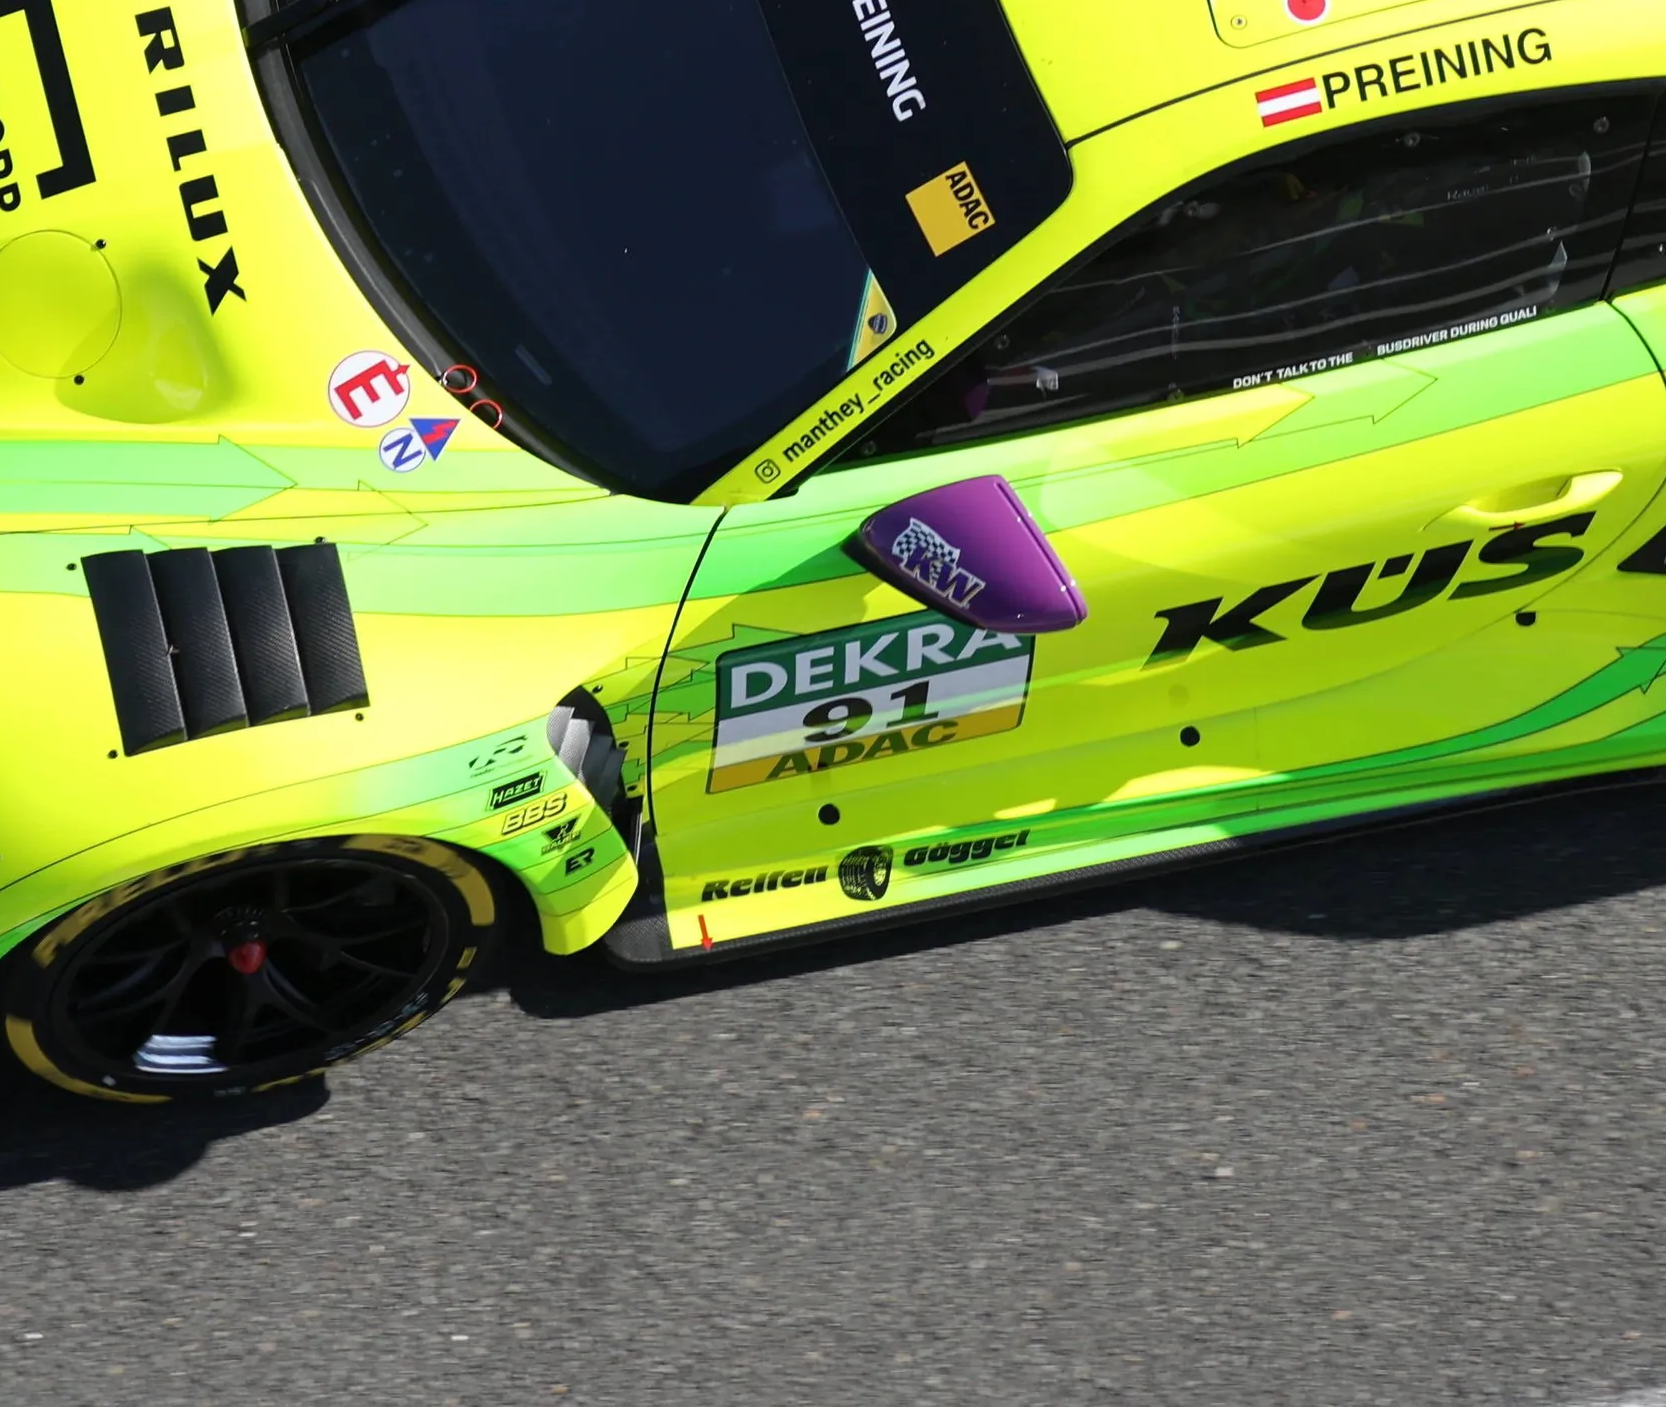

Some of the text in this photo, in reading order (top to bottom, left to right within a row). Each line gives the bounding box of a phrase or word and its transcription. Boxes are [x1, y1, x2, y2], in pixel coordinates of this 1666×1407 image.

[1321, 27, 1553, 110] PREINING
[945, 170, 989, 230] ADAC
[1277, 363, 1309, 379] TALK
[1309, 359, 1327, 372] TO
[1328, 352, 1353, 367] THE
[1377, 330, 1448, 356] BUSDRIVER
[1450, 316, 1498, 340] DURING
[1500, 306, 1537, 326] QUALI
[783, 340, 935, 463] manthey_racing
[899, 542, 986, 608] KW
[1139, 510, 1596, 671] KÜS
[730, 624, 1022, 709] DEKRA
[802, 680, 939, 743] 91
[765, 719, 959, 780] ADAC
[492, 777, 542, 803] HAZET
[502, 793, 567, 836] BBS
[701, 829, 1031, 902] Reifen Göggel
